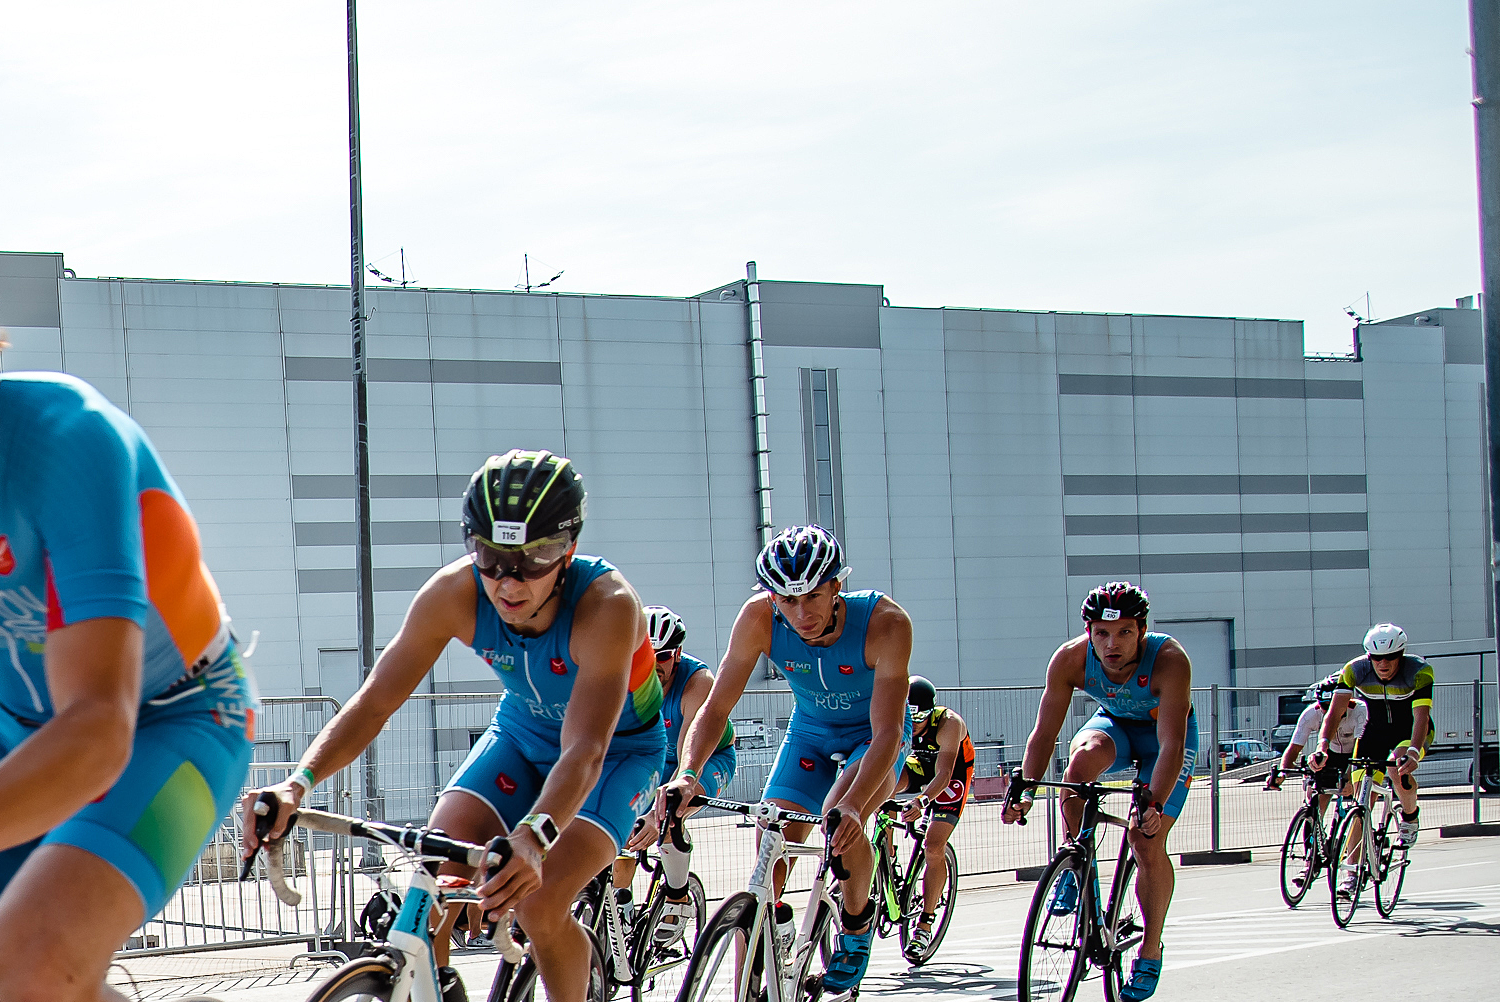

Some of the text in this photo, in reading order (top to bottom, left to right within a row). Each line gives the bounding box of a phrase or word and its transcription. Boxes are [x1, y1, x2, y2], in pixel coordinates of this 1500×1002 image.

[502, 531, 516, 541] 116
[792, 586, 803, 594] 118
[784, 660, 812, 670] ТЕМП
[814, 696, 852, 710] RUS
[1177, 747, 1196, 783] ТЕМП
[707, 800, 741, 810] GIANT
[786, 813, 823, 823] GIANT
[750, 832, 777, 885] GIANT
[411, 892, 429, 934] MEKK
